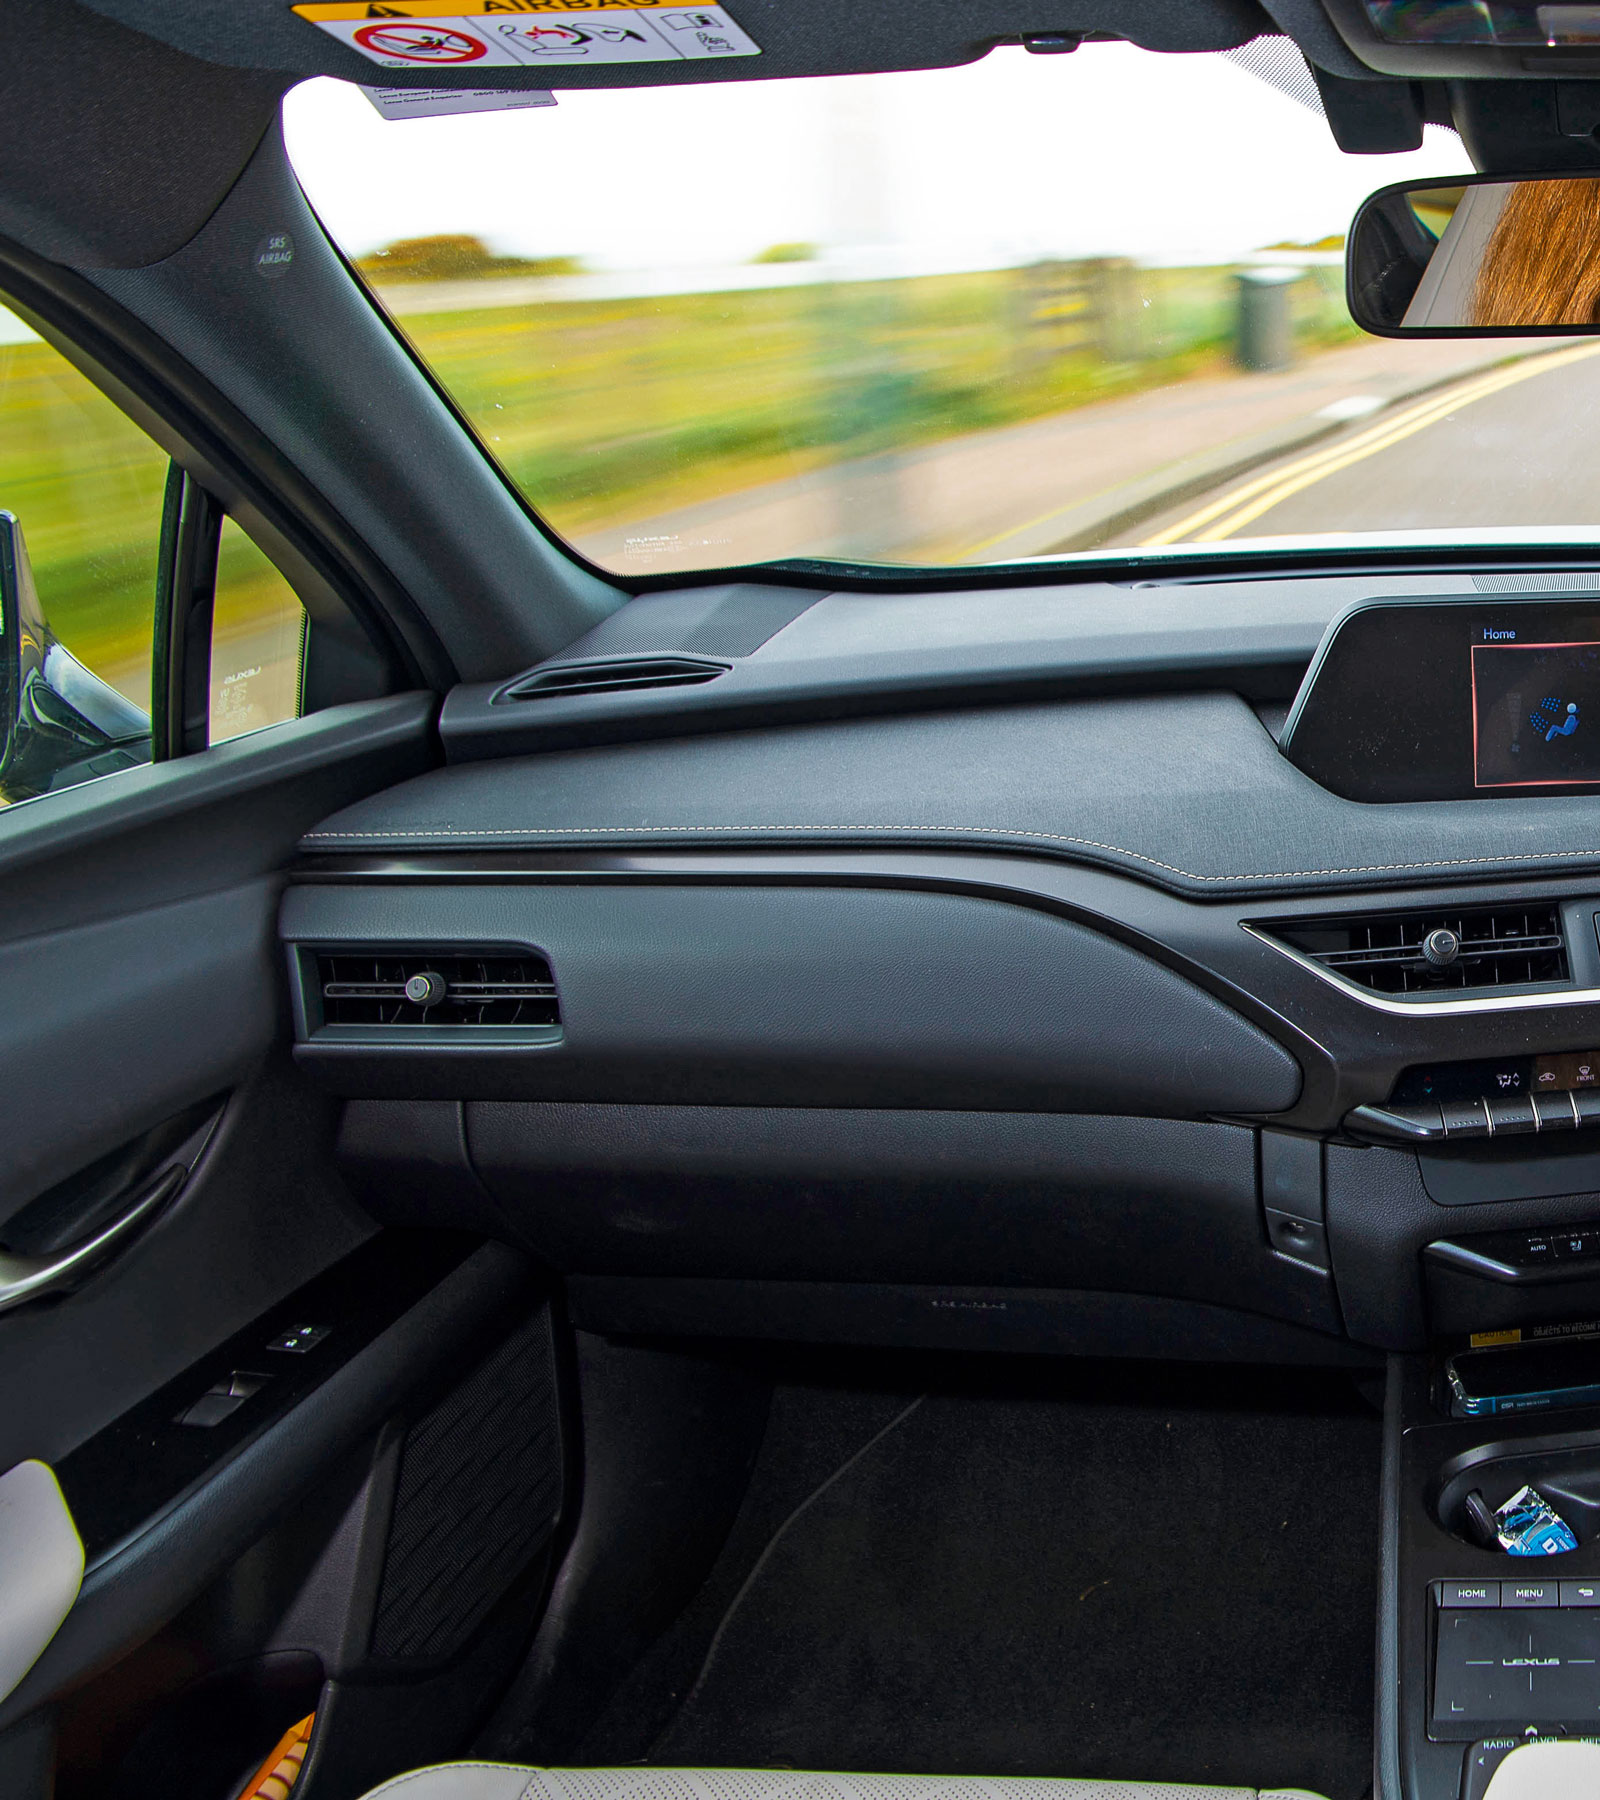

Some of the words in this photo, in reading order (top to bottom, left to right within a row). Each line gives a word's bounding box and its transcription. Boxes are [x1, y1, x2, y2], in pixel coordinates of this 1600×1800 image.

[269, 236, 287, 250] SRS
[259, 251, 293, 264] AIRBAG
[1483, 628, 1516, 640] Home
[1576, 1074, 1595, 1082] FRONT
[1478, 1331, 1514, 1339] CAUTION
[1534, 1328, 1561, 1336] OBJECTS
[1562, 1326, 1571, 1334] TO
[1572, 1324, 1596, 1333] BECOME
[1458, 1589, 1486, 1598] HOME
[1516, 1588, 1544, 1598] MENU
[1502, 1658, 1560, 1666] LEXUS
[1483, 1740, 1514, 1750] RADIO
